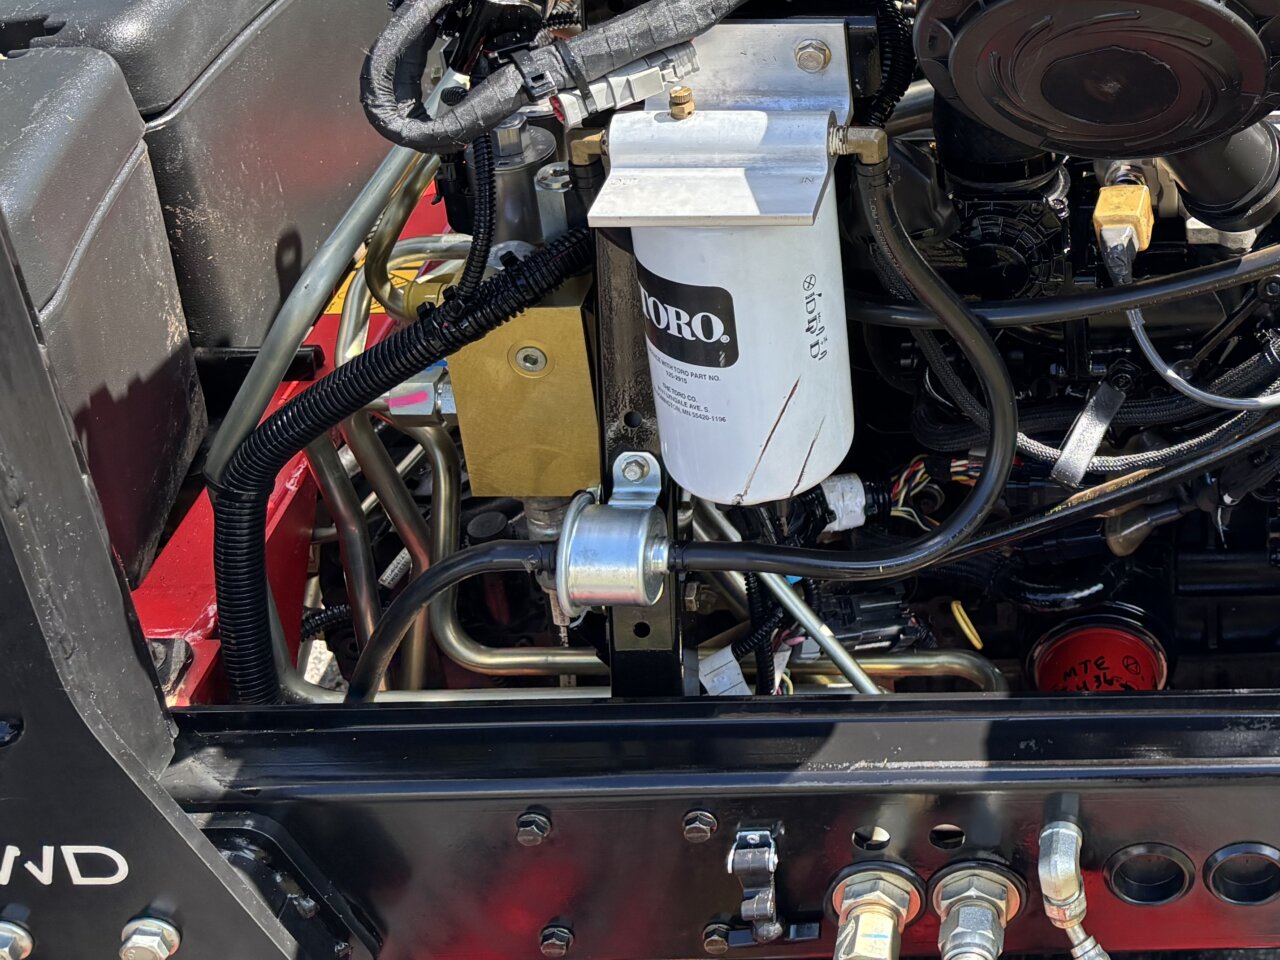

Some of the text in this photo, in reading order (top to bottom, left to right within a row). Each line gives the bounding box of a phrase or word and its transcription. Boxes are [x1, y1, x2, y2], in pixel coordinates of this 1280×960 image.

[638, 281, 724, 343] TORO
[690, 371, 707, 380] PART
[687, 394, 698, 403] CO.
